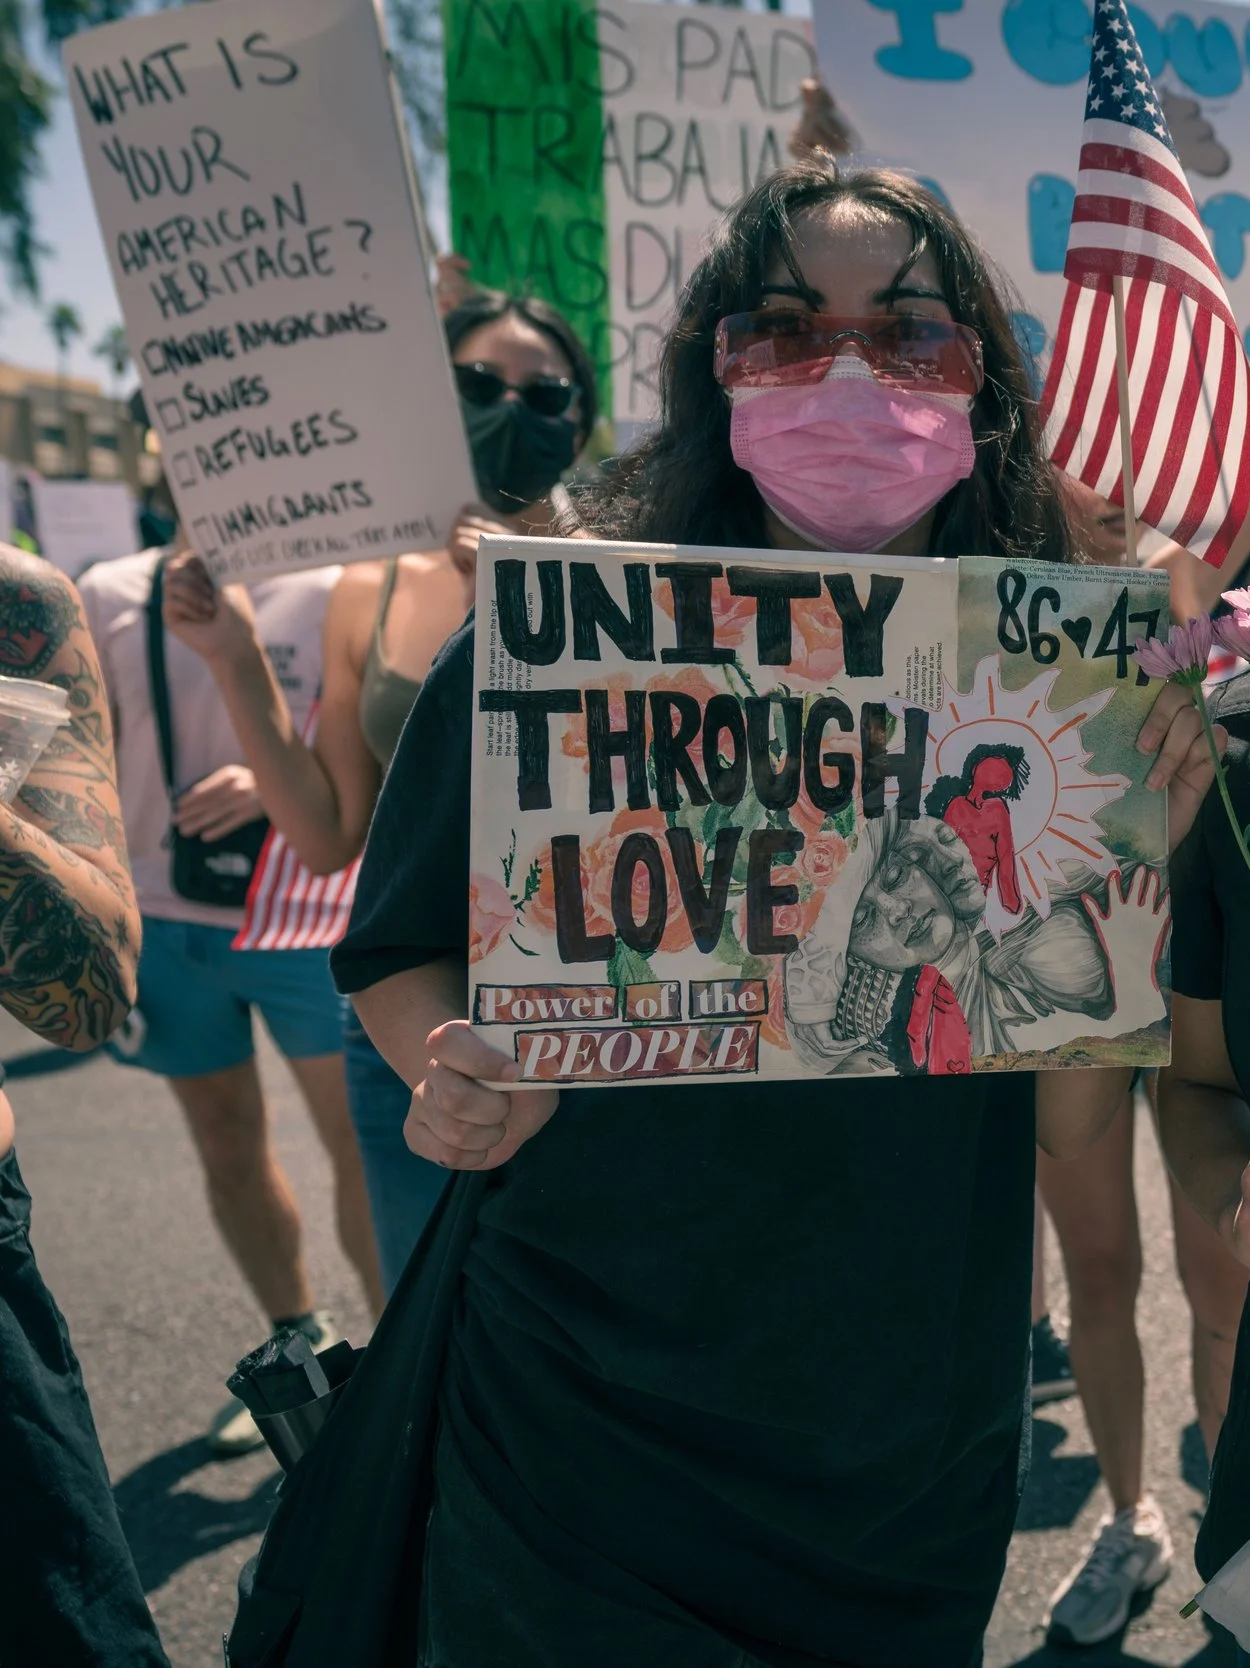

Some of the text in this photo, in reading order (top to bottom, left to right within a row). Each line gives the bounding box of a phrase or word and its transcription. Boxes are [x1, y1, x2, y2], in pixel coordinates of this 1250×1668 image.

[75, 32, 299, 126] WHAT IS
[456, 0, 638, 99] MIS
[101, 125, 250, 203] YOUR
[116, 182, 309, 277] AMERICAN
[458, 213, 608, 313] MAS
[182, 375, 272, 422] SLAVES
[197, 409, 359, 481] REFUGEES
[212, 478, 374, 548] IMMIGRANTS
[496, 560, 904, 678] UNITY
[996, 568, 1161, 687] 86 47
[479, 690, 930, 820] THROUGH
[551, 826, 805, 963] LOVE
[483, 982, 757, 1021] Power of the
[522, 1024, 755, 1078] PEOPLE
